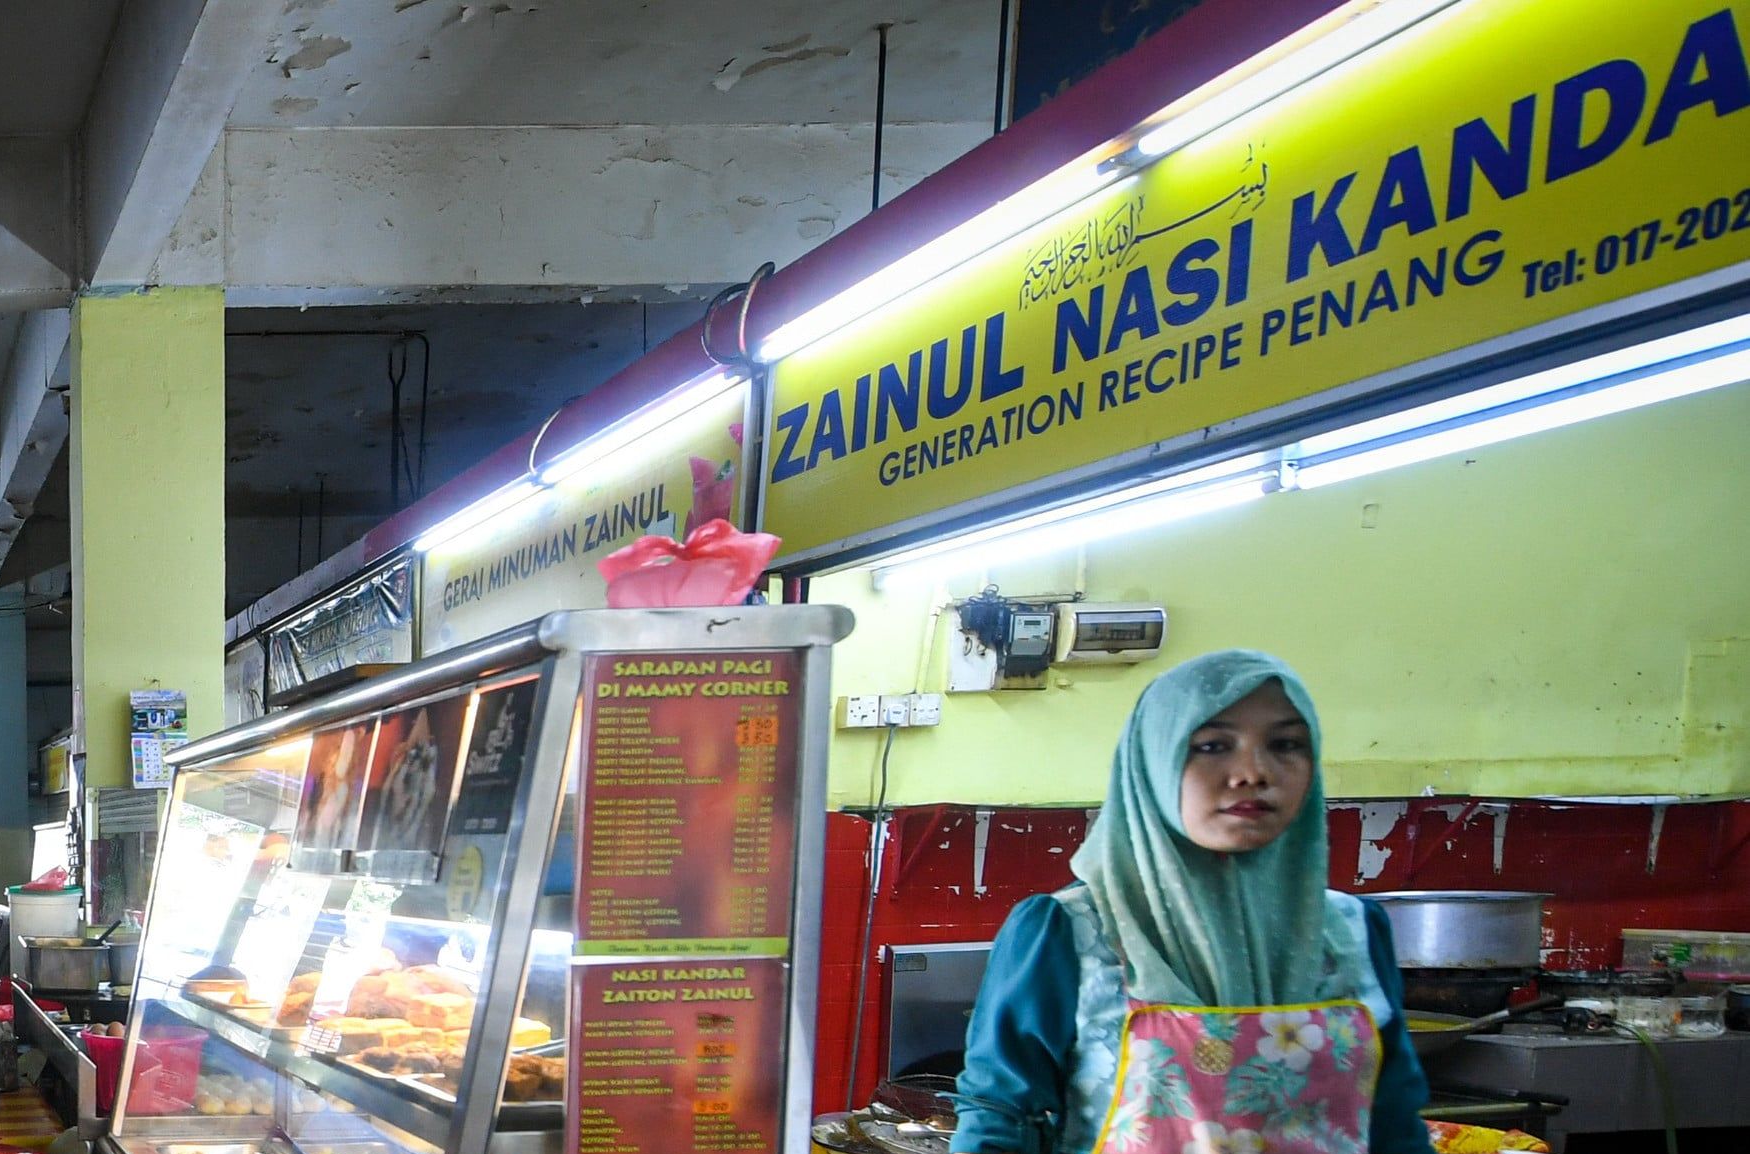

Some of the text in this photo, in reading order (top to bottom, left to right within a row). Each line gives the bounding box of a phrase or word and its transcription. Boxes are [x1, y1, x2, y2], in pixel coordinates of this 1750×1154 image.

[1522, 249, 1586, 299] Tel:
[771, 311, 1025, 484] ZAINUL
[1052, 218, 1254, 375] NASI
[879, 229, 1505, 487] GENERATION RECIPE PENANG
[443, 484, 670, 612] GERAI MINUMAN ZAINUL
[613, 659, 773, 677] SARAPAN PAGI
[597, 680, 790, 698] DI MAMY CORNER
[611, 966, 746, 982] NASI KANDAR
[602, 987, 755, 1003] ZAITON ZAINUL
